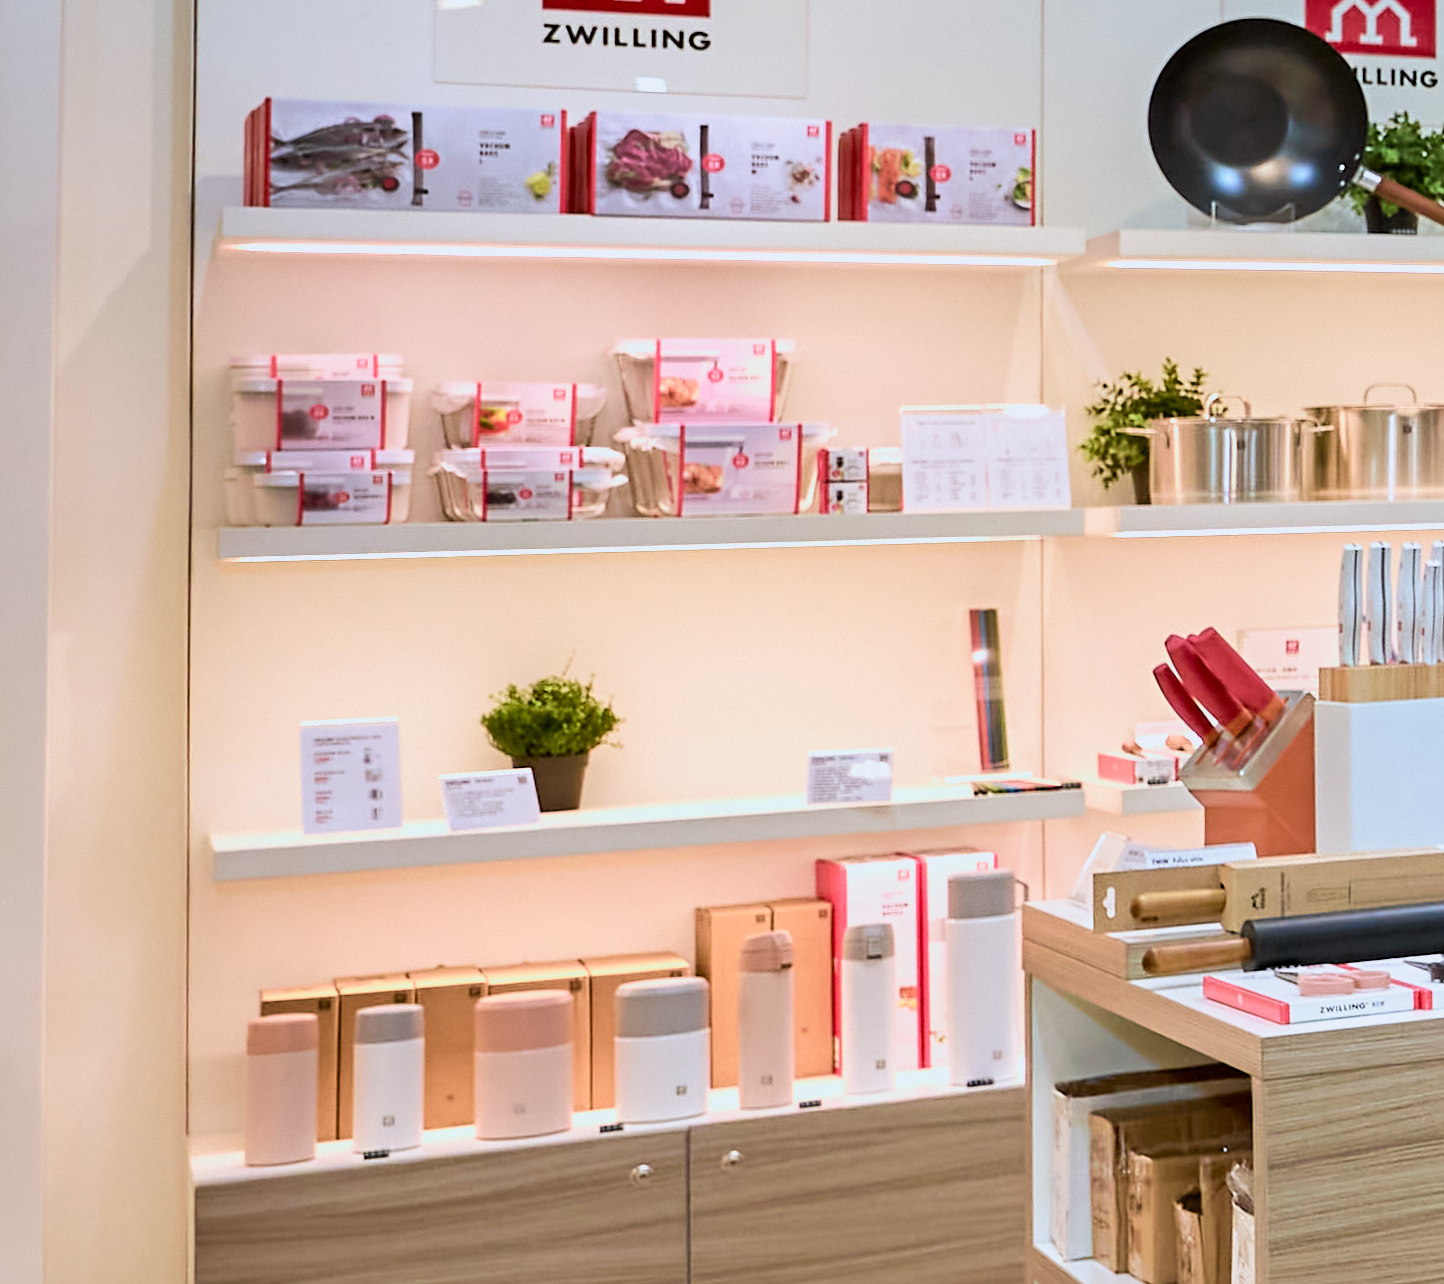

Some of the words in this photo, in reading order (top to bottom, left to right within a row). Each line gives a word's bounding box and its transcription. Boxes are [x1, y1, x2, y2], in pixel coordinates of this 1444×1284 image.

[543, 23, 711, 51] ZWILLING
[1352, 67, 1438, 88] ILLING
[1320, 1002, 1367, 1014] ZWILLING
